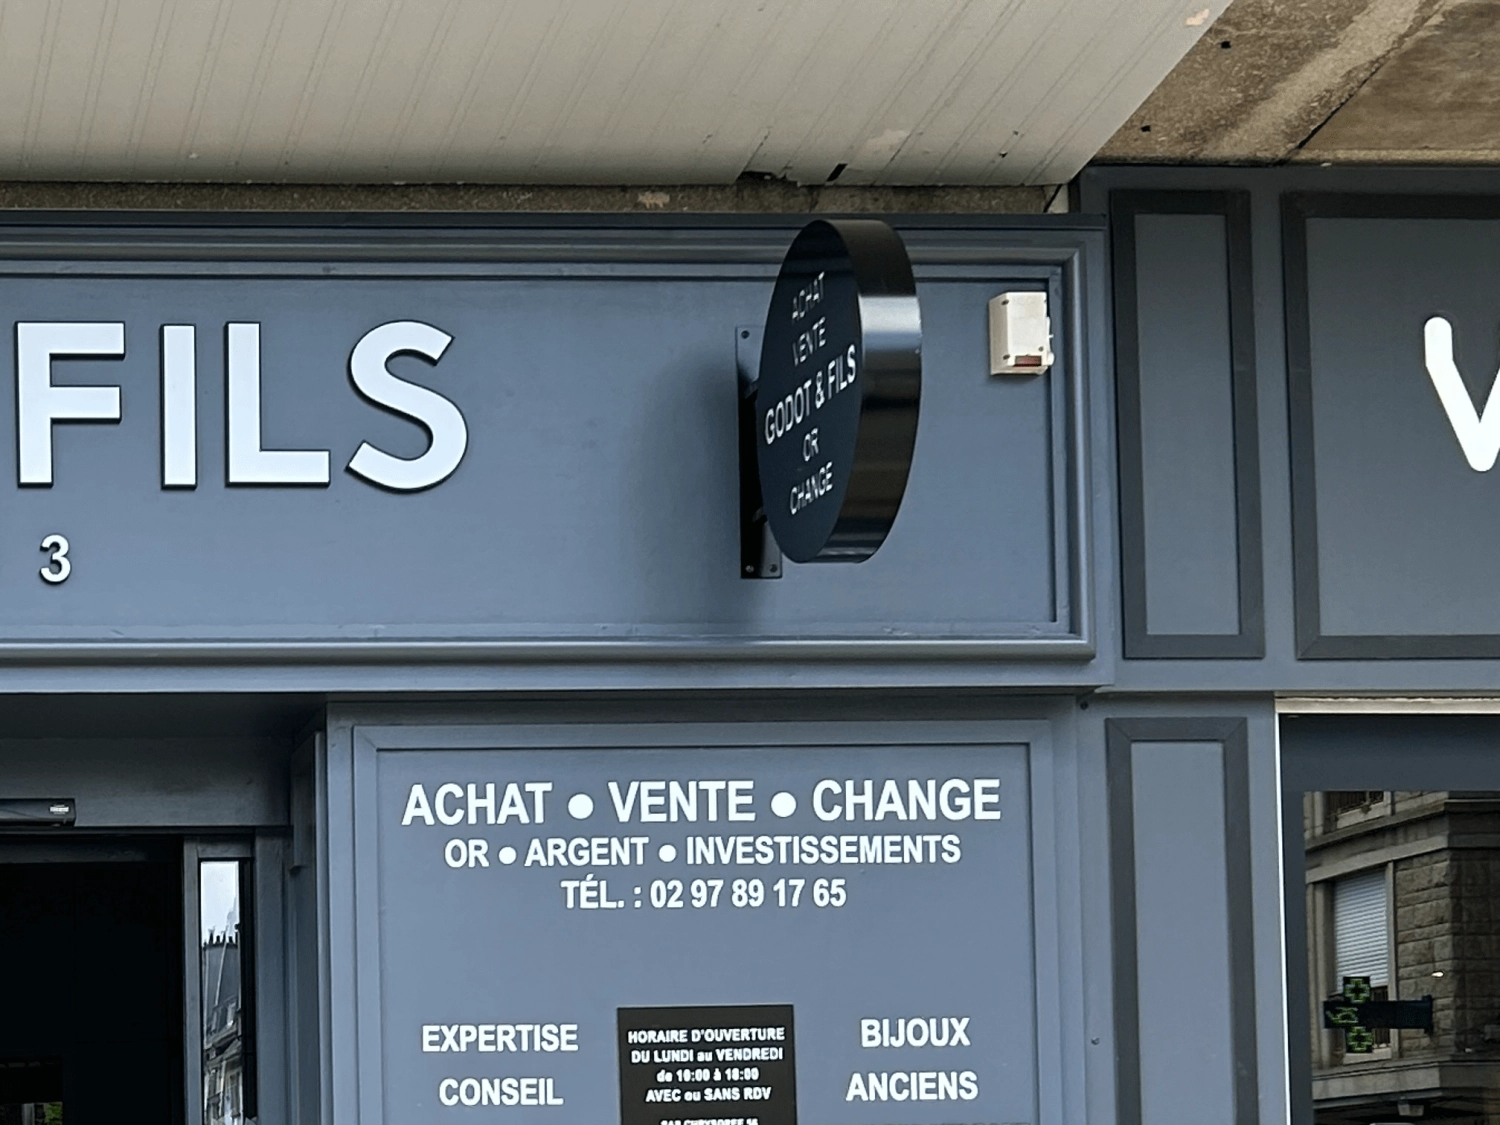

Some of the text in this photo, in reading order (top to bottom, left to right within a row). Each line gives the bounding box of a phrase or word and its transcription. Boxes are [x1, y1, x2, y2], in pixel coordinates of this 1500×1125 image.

[14, 319, 470, 494] FILS
[764, 344, 857, 445] GODOT & FILS
[803, 427, 819, 462] OR
[789, 461, 834, 515] CHANGE
[401, 778, 1001, 826] ACHAT VENTE CHANGE
[445, 834, 961, 868] OR ARGENT INVESTISSEMENTS
[560, 873, 625, 909] TÉL.
[650, 879, 684, 908] 02
[690, 879, 724, 908] 97
[731, 879, 764, 907] 89
[773, 878, 805, 907] 17
[813, 878, 847, 907] 65
[422, 1024, 579, 1052] EXPERTISE
[627, 1027, 785, 1044] HORAIRE D'OUVERTURE
[861, 1017, 971, 1048] BIJOUX
[631, 1047, 783, 1063] DU LUNDI au VENDREDI
[656, 1069, 672, 1082] de
[845, 1071, 978, 1101] ANCIENS
[439, 1077, 564, 1106] CONSEIL
[646, 1087, 772, 1103] AVEC ou SANS RDV
